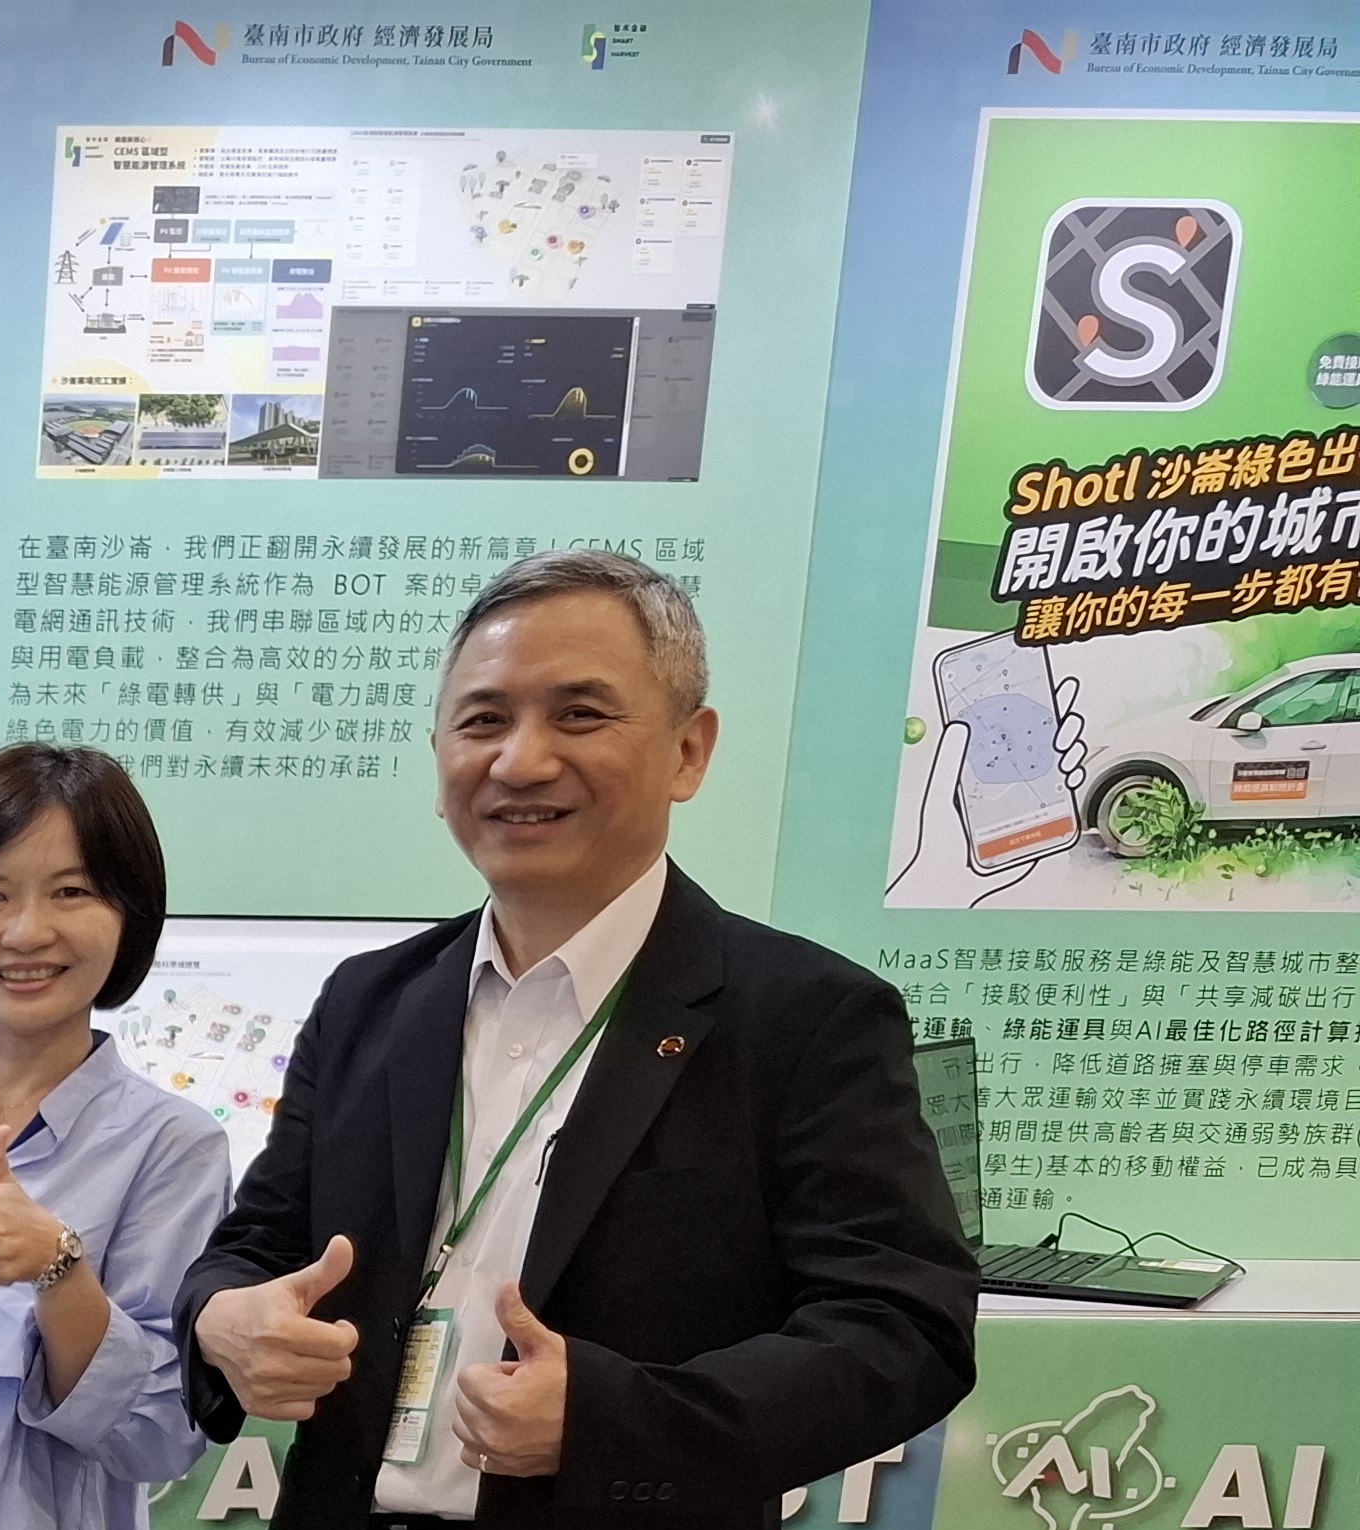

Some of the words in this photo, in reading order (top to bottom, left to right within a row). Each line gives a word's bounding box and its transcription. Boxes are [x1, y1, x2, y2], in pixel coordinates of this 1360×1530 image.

[243, 23, 365, 48] 臺南市政府
[374, 24, 494, 49] 經濟發展局
[1090, 31, 1211, 57] 臺南市政府
[1220, 33, 1339, 60] 經濟發展局
[241, 54, 276, 65] Bureau
[277, 54, 289, 65] of
[290, 55, 340, 66] Economic
[413, 56, 445, 67] Tainan
[448, 56, 470, 69] City
[474, 57, 532, 68] Government
[1087, 62, 1118, 73] Bureau
[1136, 63, 1184, 74] Economic
[1257, 65, 1289, 75] Tainan
[1292, 65, 1313, 78] City
[1011, 455, 1143, 516] Shotl
[1146, 432, 1360, 500] 沙崙綠色出
[655, 537, 706, 562] 區域
[15, 571, 314, 597] 型智慧能源管理系統作為
[333, 573, 388, 596] BOT
[404, 573, 493, 599] 案的卓
[1020, 557, 1360, 642] 讓你的每一步都有
[12, 608, 466, 635] 電網通訊技術，我們串聯區域內的太
[910, 1015, 1360, 1043] 運輸、綠能運具與AI最佳化路徑計算
[1180, 1444, 1326, 1530] AI
